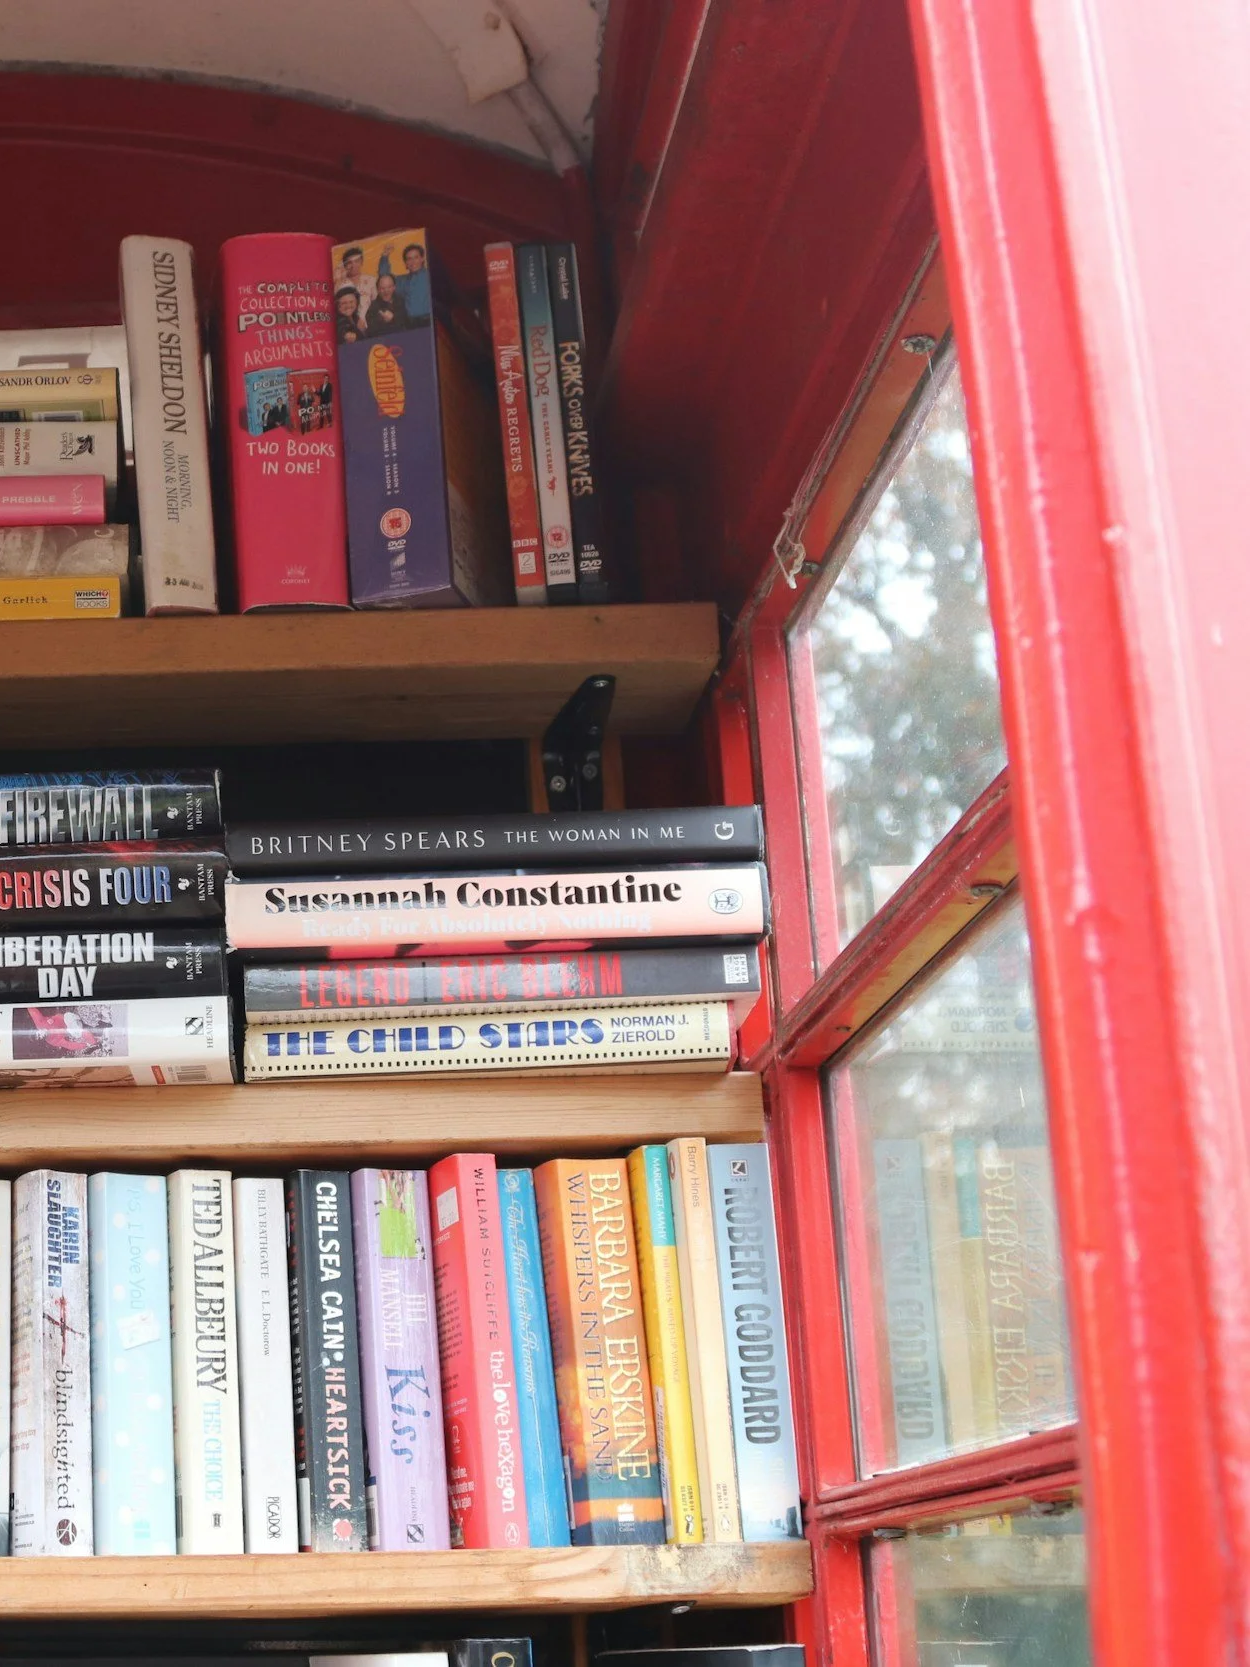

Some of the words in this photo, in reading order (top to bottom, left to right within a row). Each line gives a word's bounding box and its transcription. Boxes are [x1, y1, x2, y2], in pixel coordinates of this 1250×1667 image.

[152, 251, 180, 330] SIDNEY
[240, 296, 316, 313] COLLECTION
[256, 326, 313, 345] THINGS
[530, 325, 550, 359] Red
[34, 375, 72, 386] ORLOV
[158, 331, 188, 435] SHELDON
[558, 341, 584, 396] FORKS
[163, 440, 176, 473] NOON
[246, 442, 279, 456] TWO
[287, 440, 336, 458] BOOKS
[285, 459, 321, 474] ONE!
[506, 406, 523, 473] REGRETS
[568, 432, 594, 497] KNIVES
[166, 486, 180, 523] NIGHT
[513, 538, 538, 548] BBC
[0, 785, 160, 847] FIREWALL
[251, 833, 372, 855] BRITNEY
[384, 829, 485, 851] SPEARS
[504, 830, 538, 844] THE
[549, 828, 621, 842] WOMAN
[660, 826, 686, 839] ME
[100, 865, 172, 906] FOUR
[264, 882, 447, 914] Susannah
[457, 874, 683, 909] Constantine
[302, 916, 373, 941] Ready
[557, 907, 653, 931] Nothing
[37, 965, 98, 999] DAY
[300, 963, 410, 1009] LEGEND
[439, 957, 508, 1003] ERIC
[262, 1030, 335, 1057] THE
[346, 1025, 466, 1054] CHILD
[479, 1017, 605, 1049] STARS
[611, 1014, 675, 1029] NORMAN
[611, 1029, 676, 1044] ZIEROLD
[652, 1157, 665, 1210] MARGARET
[686, 1145, 697, 1175] Barry
[191, 1179, 223, 1239] TED
[473, 1167, 490, 1240] WILLIAM
[690, 1177, 701, 1208] Hines
[46, 1179, 62, 1288] SLAUGHTER
[62, 1206, 80, 1265] KARIN
[128, 1236, 145, 1274] Love
[315, 1181, 342, 1282] CHELSEA
[588, 1169, 636, 1326] BARBARA
[724, 1186, 769, 1296] ROBERT
[193, 1240, 228, 1395] ALLBEURY
[261, 1312, 271, 1357] Doctorow
[321, 1291, 345, 1350] CAIN
[380, 1268, 403, 1350] MANSELL
[566, 1173, 596, 1303] WHISPERS
[589, 1407, 616, 1482] SAND
[734, 1302, 782, 1445] GODDARD
[384, 1364, 431, 1465] Kiss
[604, 1335, 652, 1481] ERSKINE
[52, 1369, 76, 1511] blindsighted
[324, 1366, 352, 1511] HEARTSICK
[204, 1438, 224, 1501] CHOICE
[496, 1427, 516, 1514] hexagon
[267, 1496, 281, 1539] PICADOR
